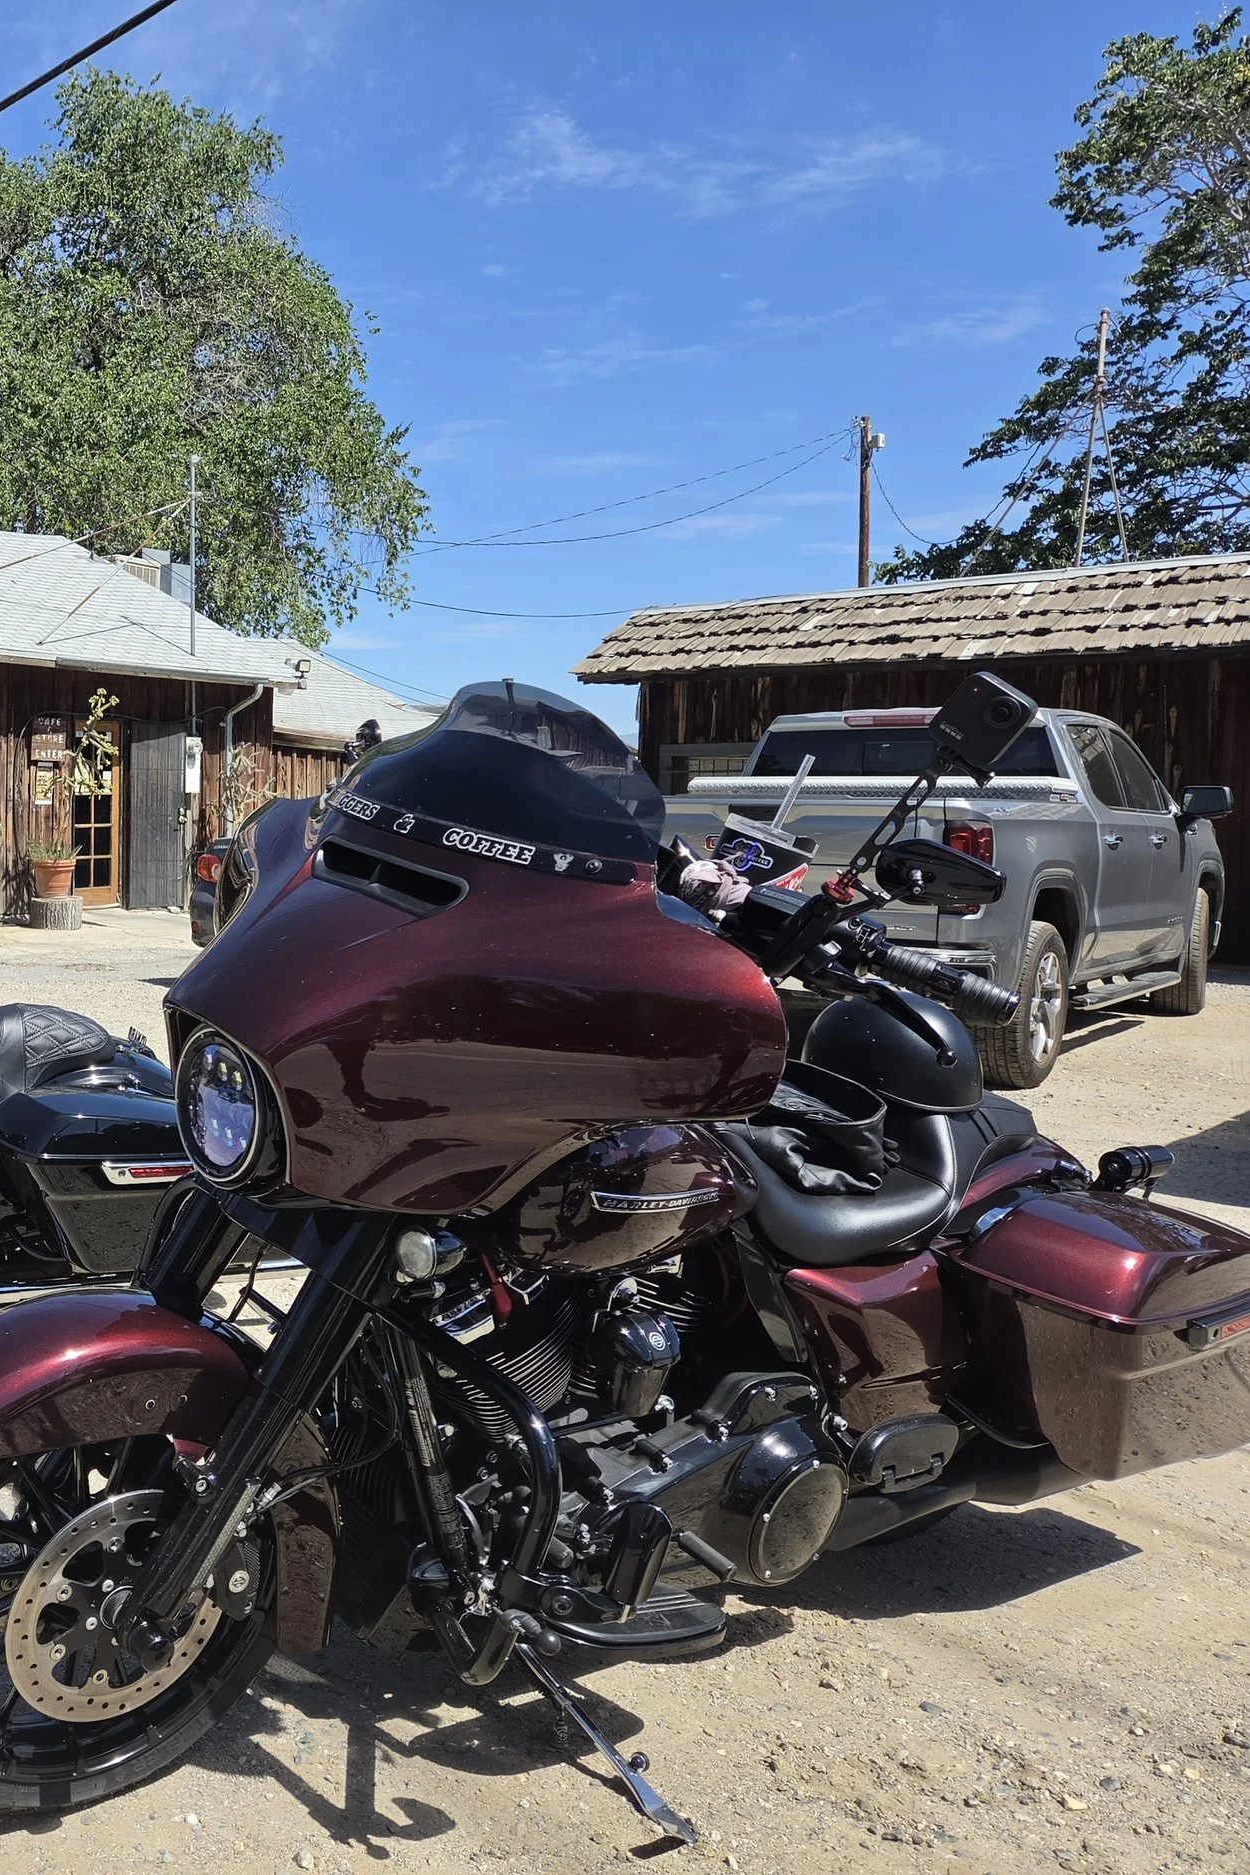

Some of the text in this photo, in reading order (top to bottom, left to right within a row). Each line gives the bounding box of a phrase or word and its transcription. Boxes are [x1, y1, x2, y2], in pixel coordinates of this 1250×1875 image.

[36, 734, 64, 744] STORE
[35, 749, 63, 760] ENTER
[393, 813, 416, 834] &
[442, 827, 536, 865] COFFEE
